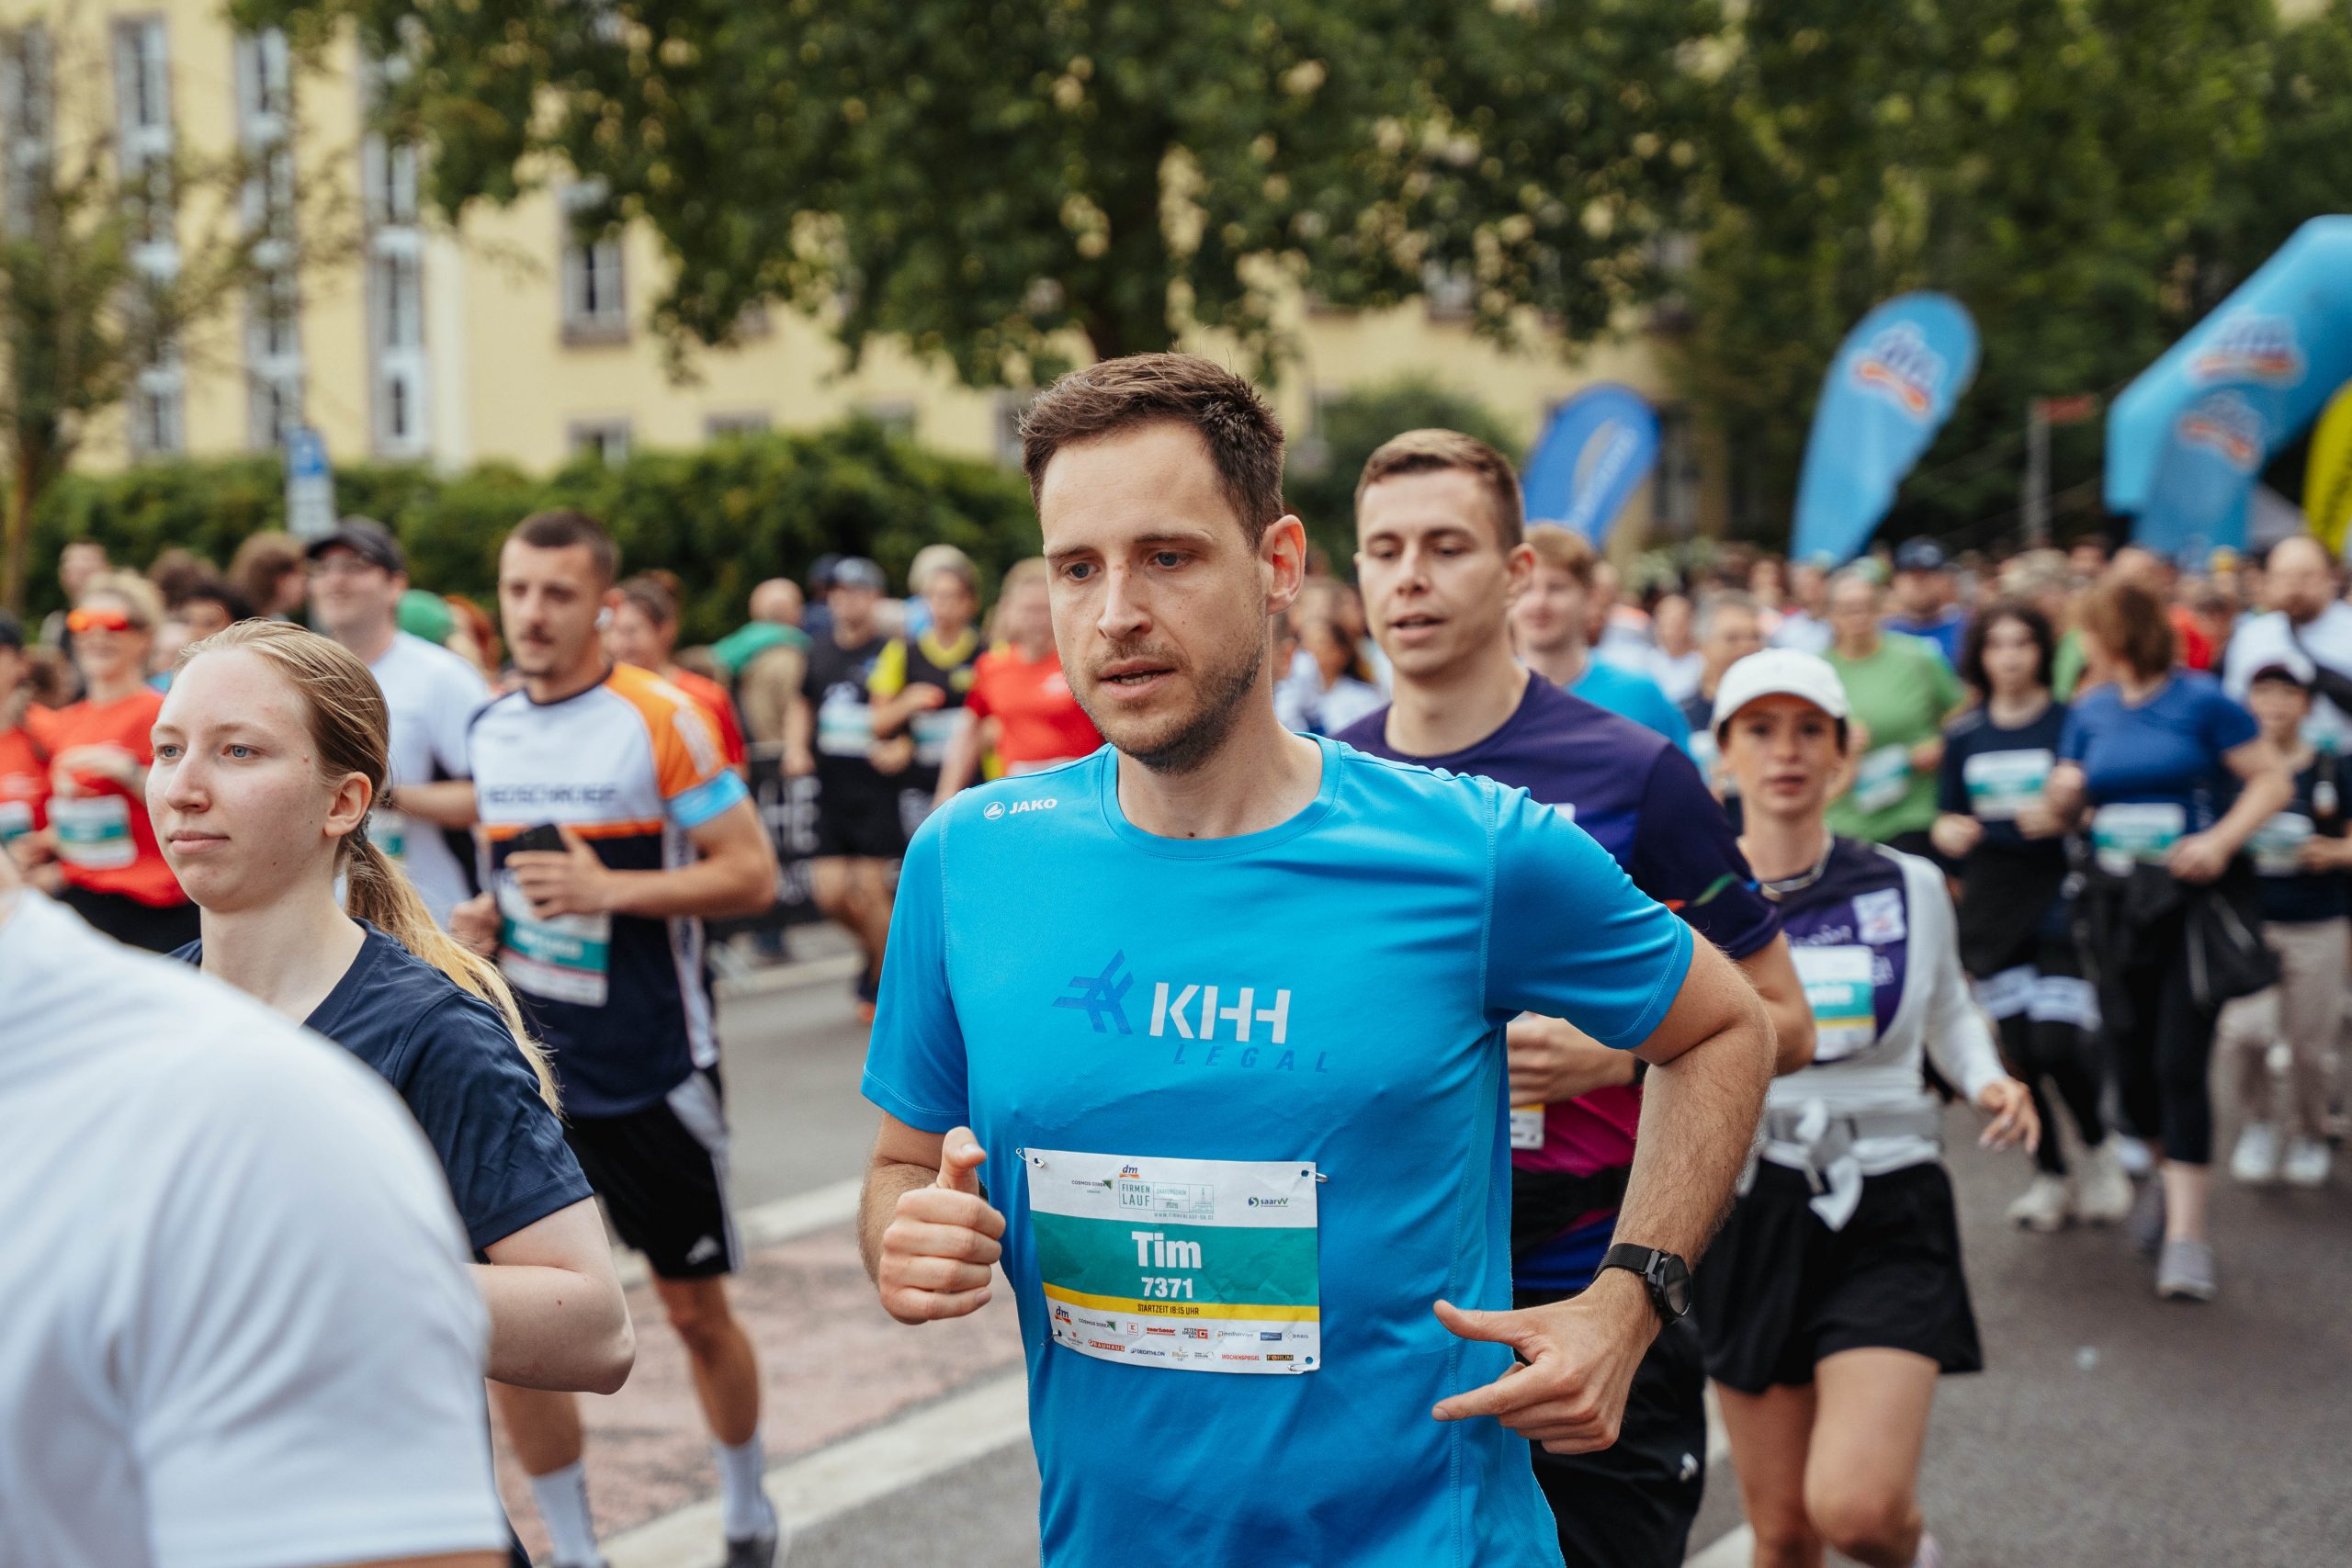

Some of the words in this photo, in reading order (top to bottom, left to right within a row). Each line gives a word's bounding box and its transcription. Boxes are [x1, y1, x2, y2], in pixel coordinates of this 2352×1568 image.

[1009, 798, 1057, 815] JAKO
[1173, 1043, 1329, 1073] LEGAL
[1122, 1165, 1138, 1174] dm
[1122, 1184, 1150, 1193] FIRMEN
[1122, 1194, 1150, 1206] LAUF
[1131, 1231, 1202, 1269] Tim
[1141, 1277, 1193, 1299] 7371
[1056, 1306, 1069, 1318] dm
[1137, 1303, 1169, 1314] STARTZEIT
[1170, 1306, 1184, 1314] 18:15
[1092, 1341, 1125, 1352] BAUHAUS
[1136, 1348, 1165, 1357] DECATHLON
